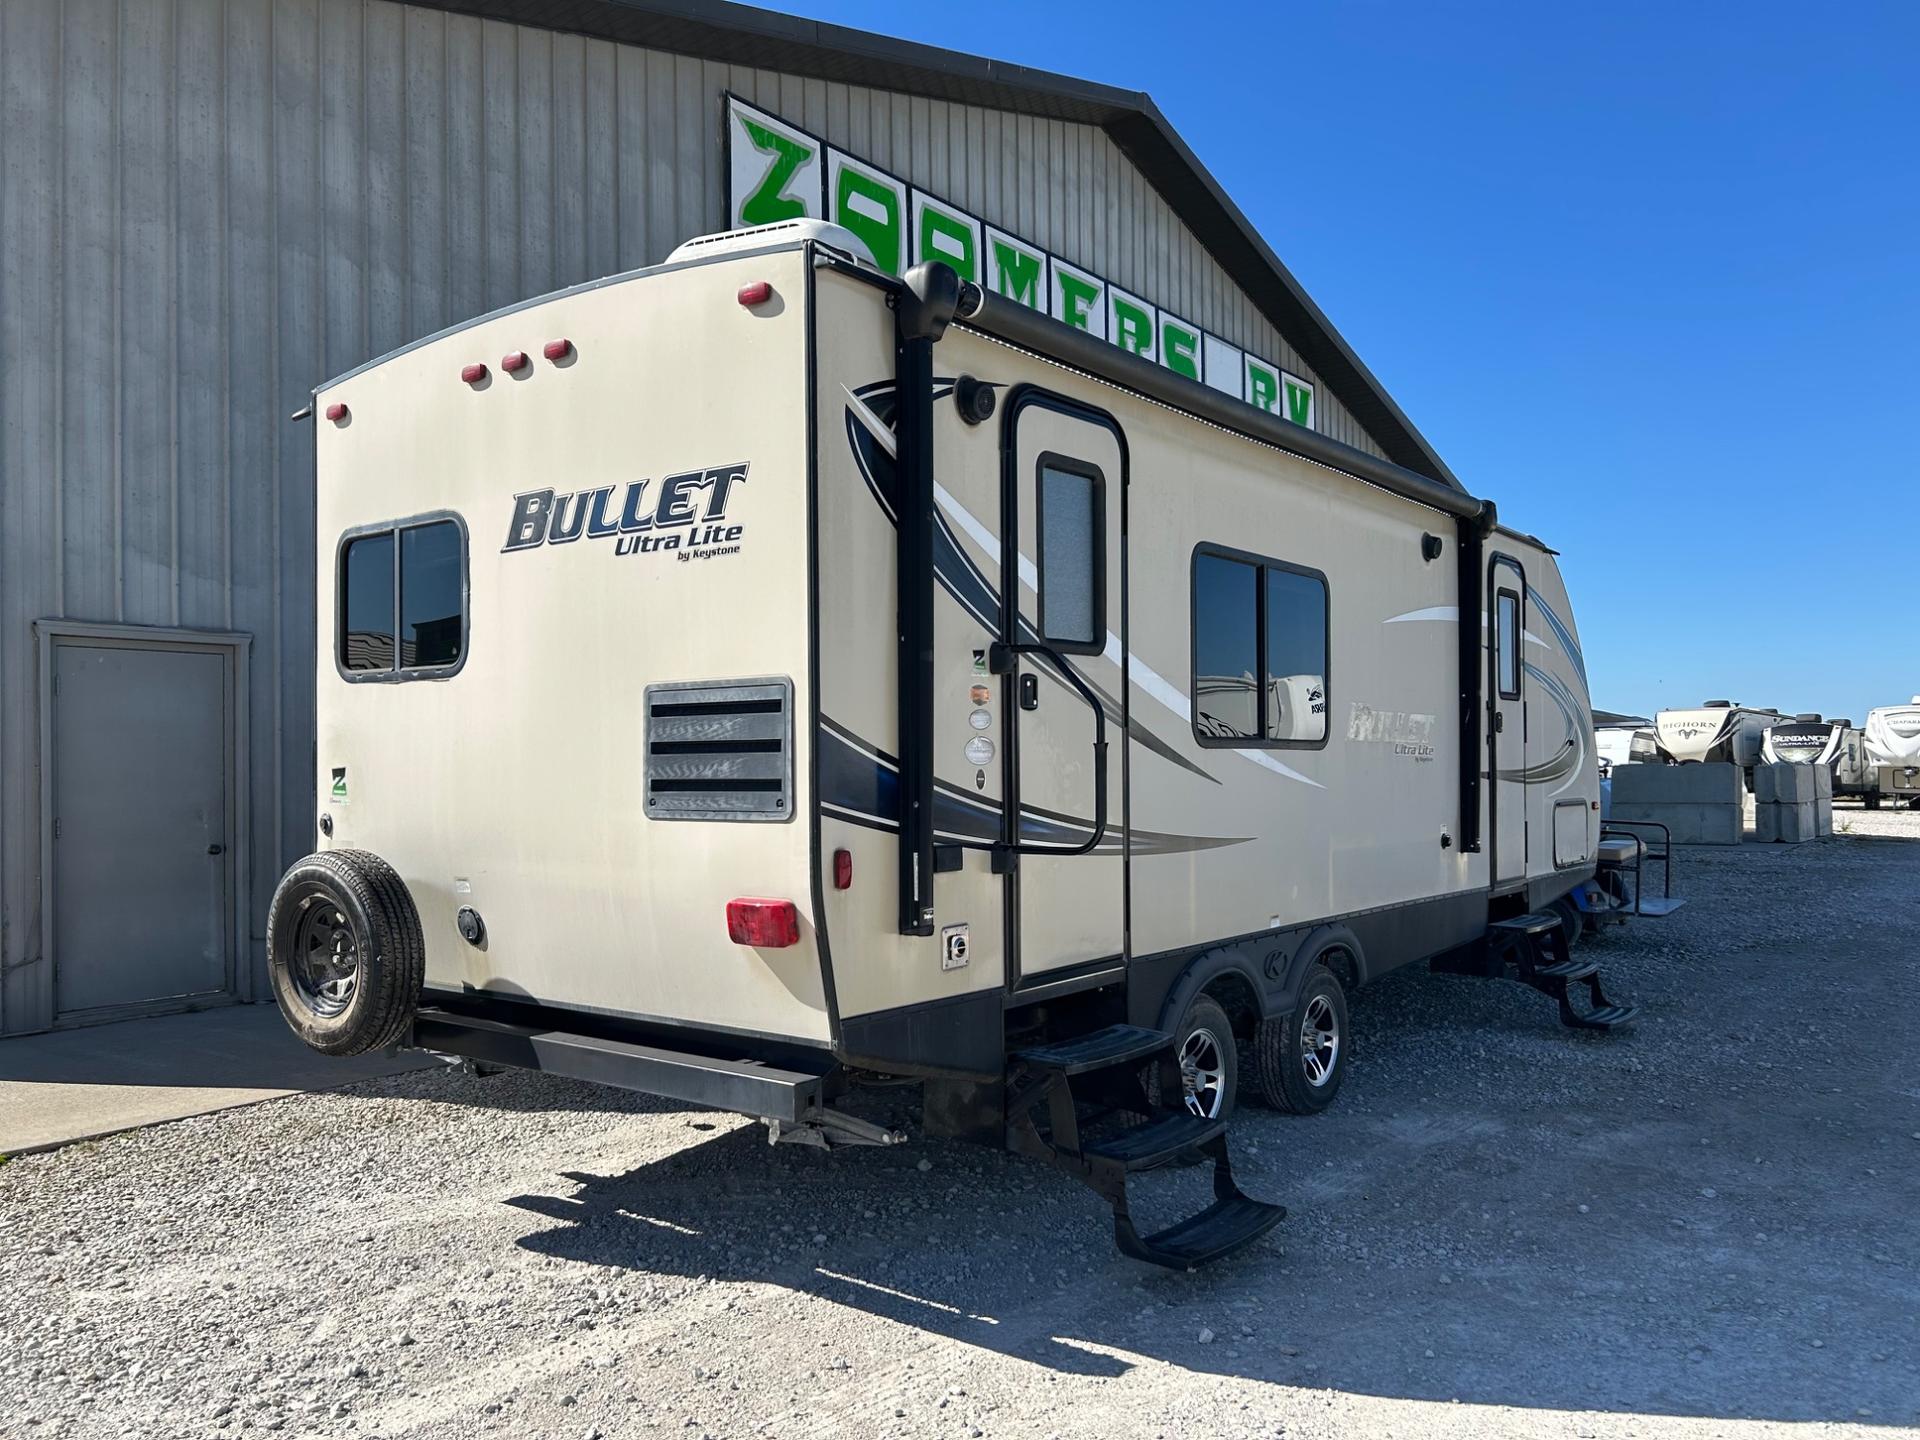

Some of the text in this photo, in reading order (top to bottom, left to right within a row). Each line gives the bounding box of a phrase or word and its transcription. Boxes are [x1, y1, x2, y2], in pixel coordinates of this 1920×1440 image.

[731, 107, 1312, 431] ZOOMERS RV
[500, 460, 750, 553] BULLET
[614, 525, 743, 556] Ultra Lite
[678, 545, 740, 562] by Keystone
[1662, 721, 1717, 730] BIGHORN
[1771, 734, 1829, 743] SUNDANCE
[1394, 743, 1434, 756] Ultra Lite
